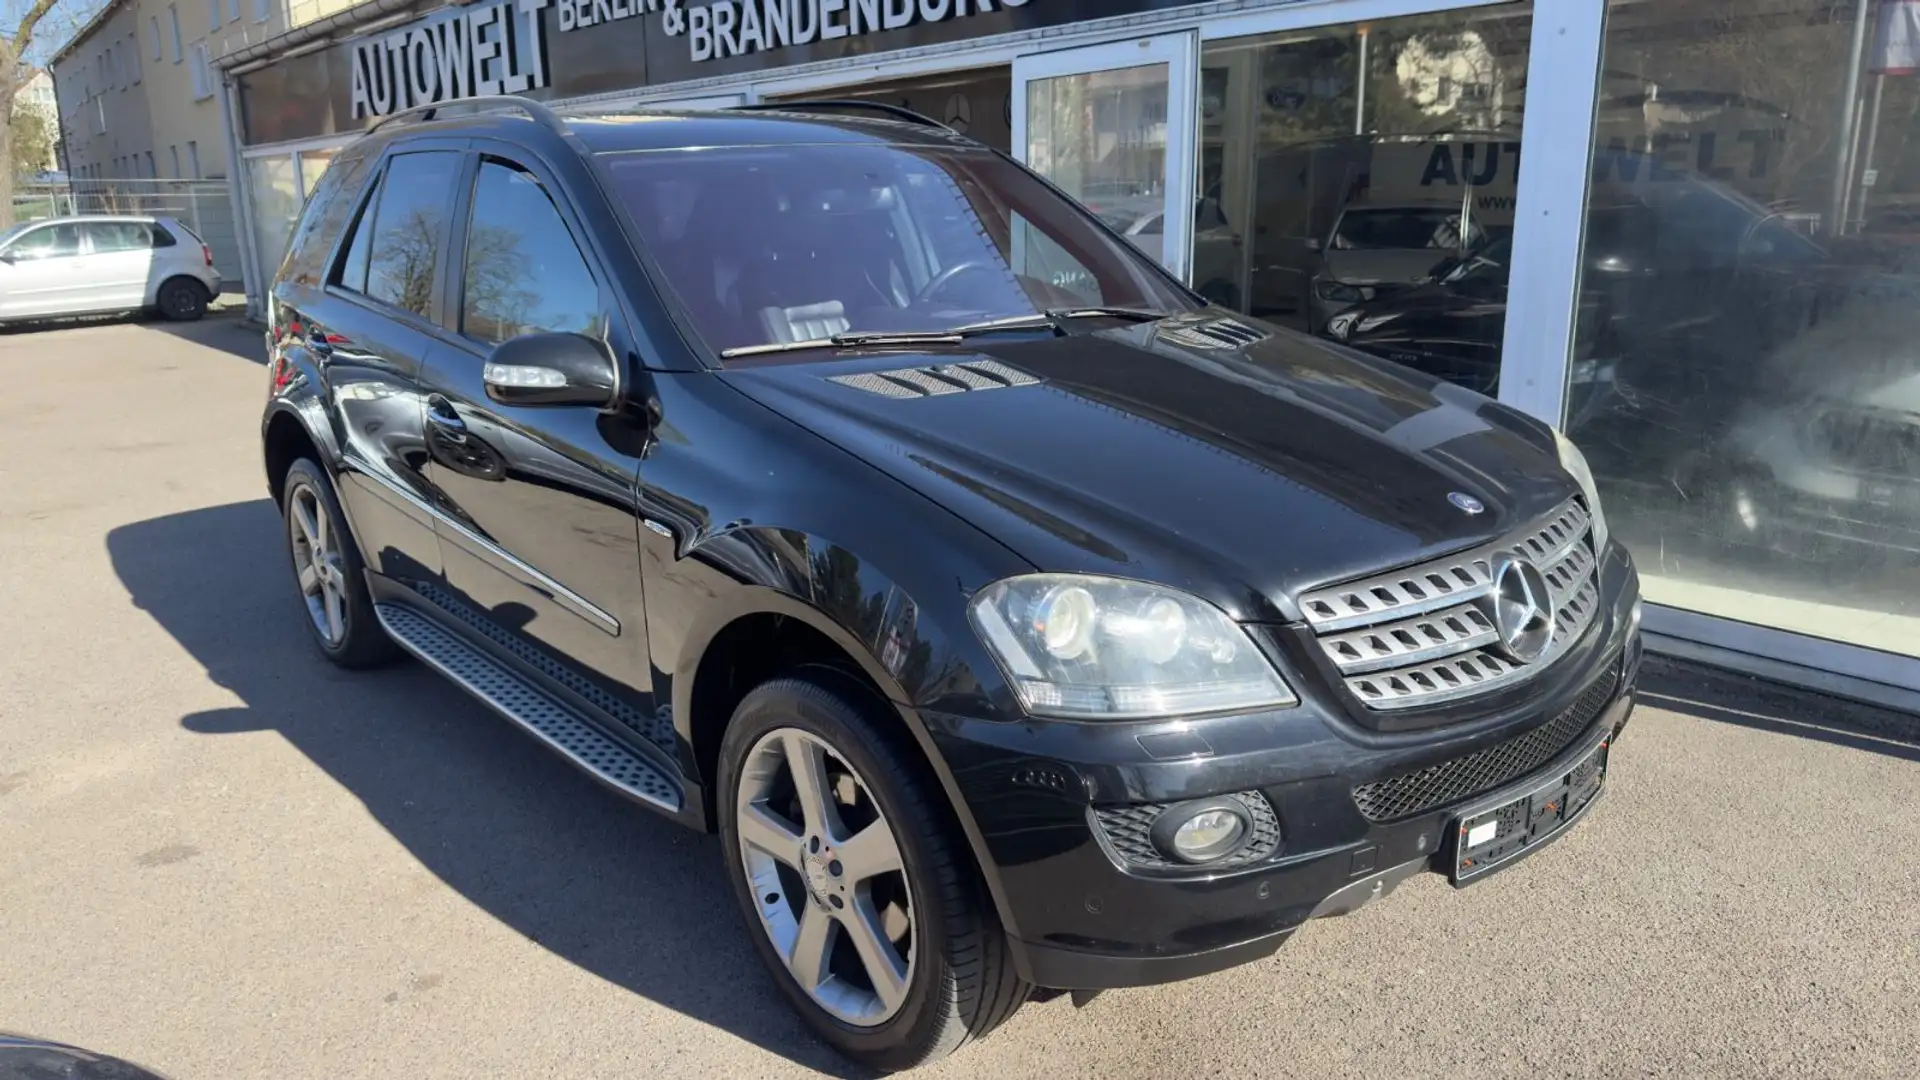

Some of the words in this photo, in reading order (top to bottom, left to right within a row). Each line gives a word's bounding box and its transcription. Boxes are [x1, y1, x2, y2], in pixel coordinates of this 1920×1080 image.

[663, 0, 686, 36] &
[688, 0, 1030, 62] BRANDENB
[352, 0, 547, 120] AUTOWELT
[1420, 129, 1785, 187] AUTWELT
